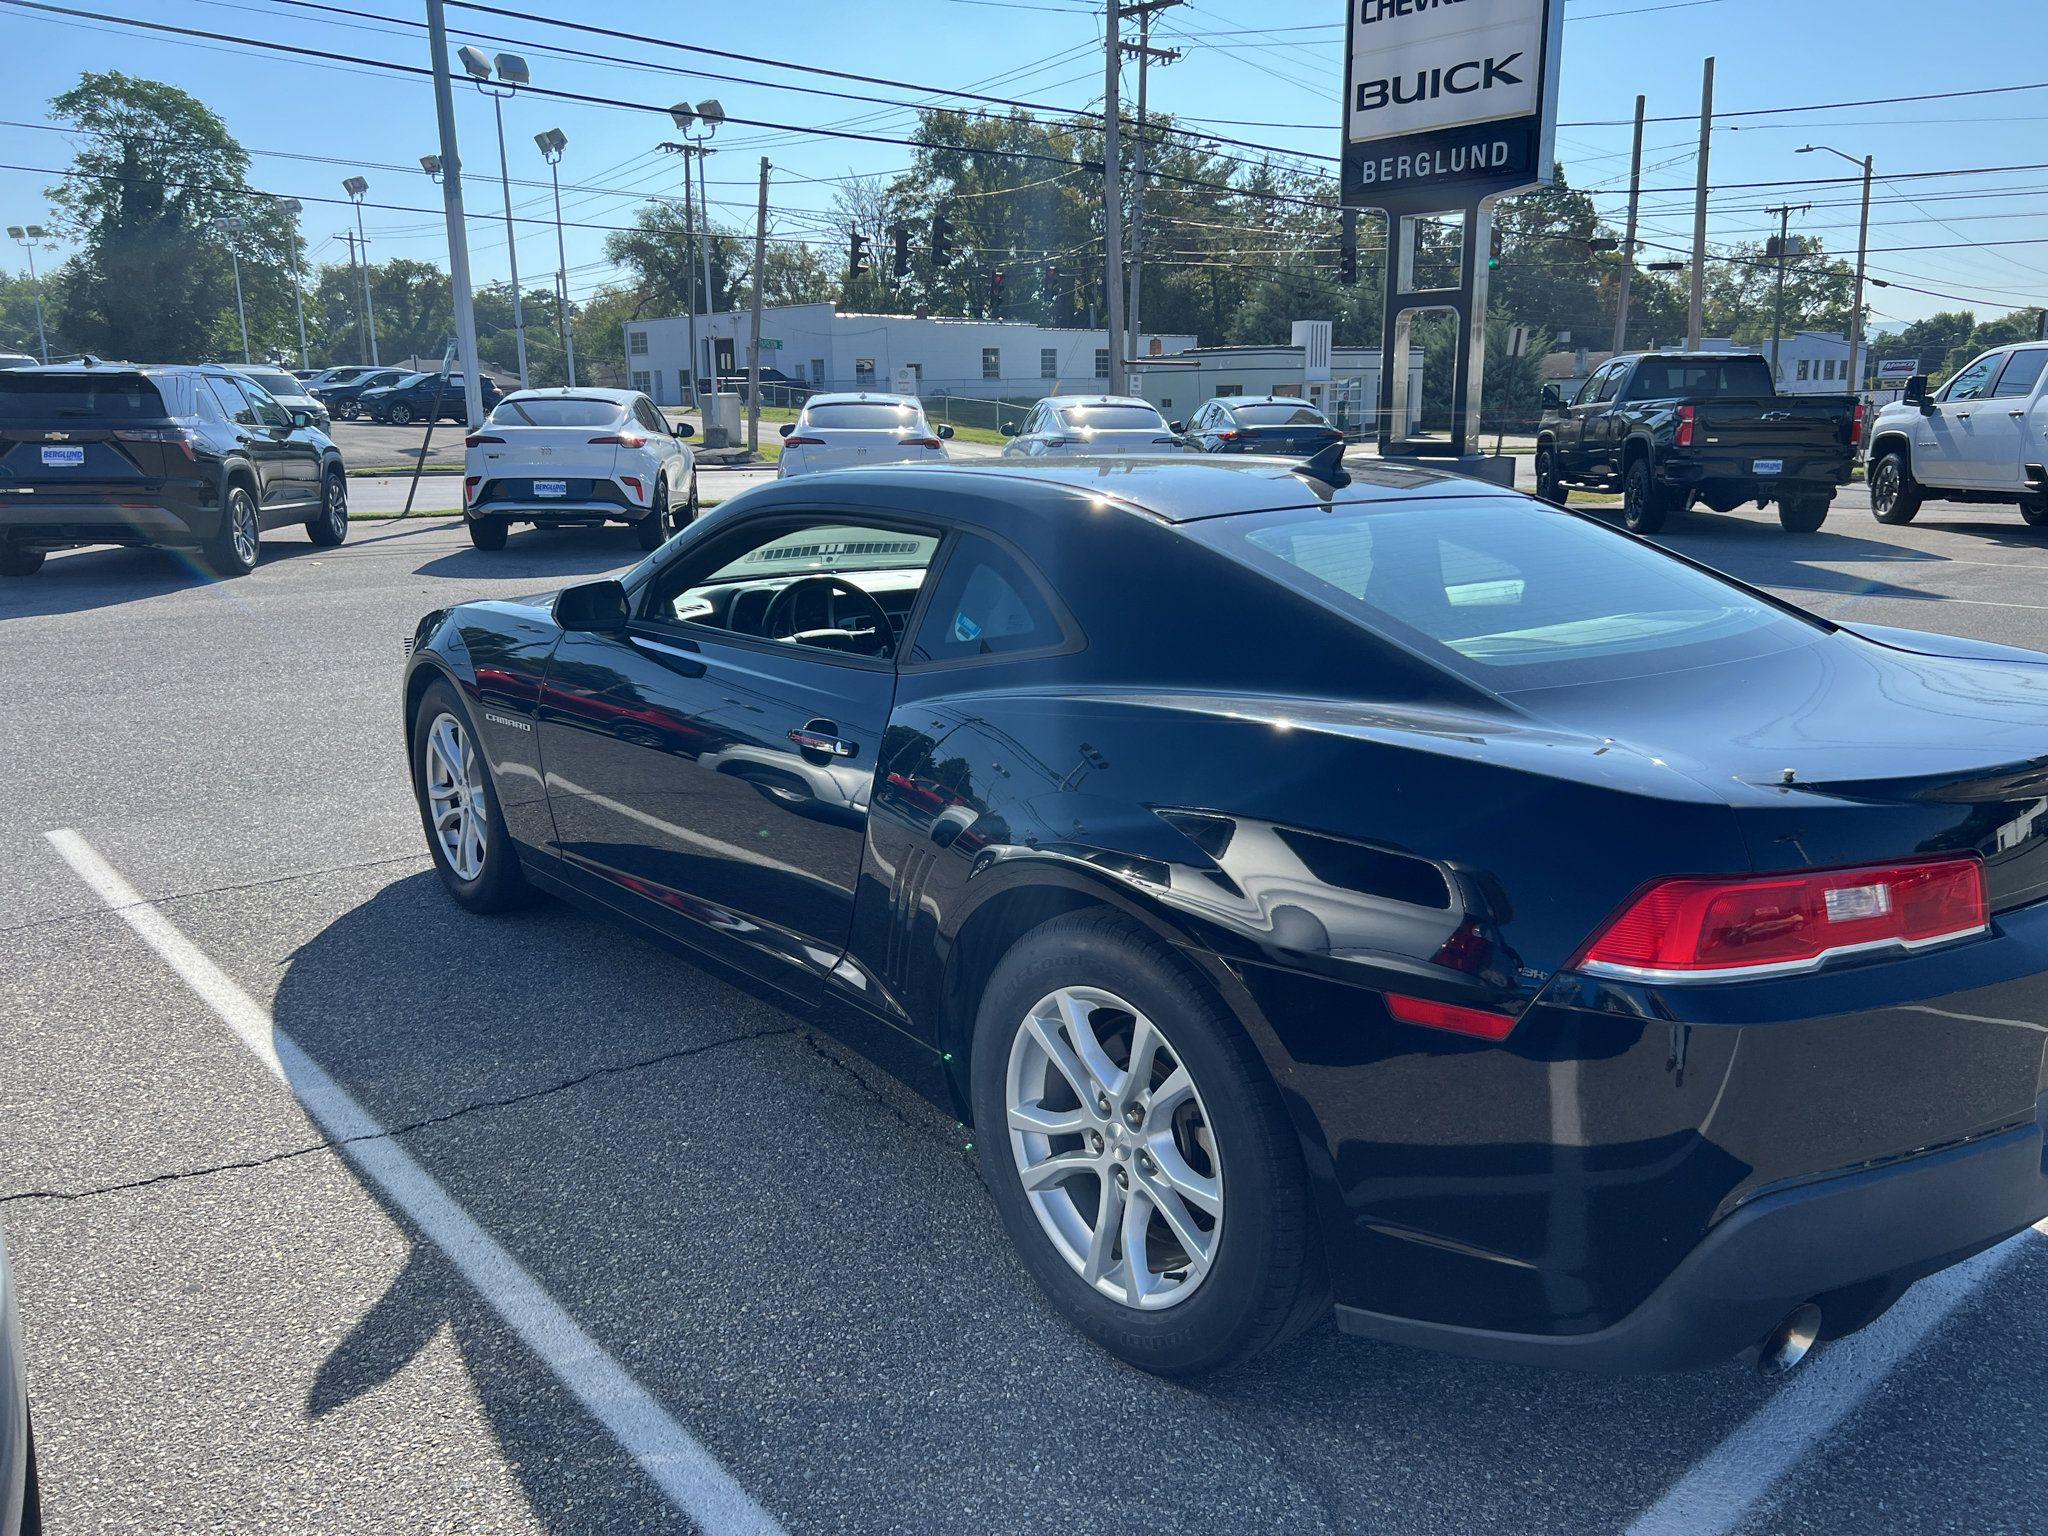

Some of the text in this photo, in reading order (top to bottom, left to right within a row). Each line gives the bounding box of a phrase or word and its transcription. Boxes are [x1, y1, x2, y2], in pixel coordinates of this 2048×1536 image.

[1356, 52, 1523, 112] BUICK
[1362, 141, 1508, 184] BERGLUND
[43, 450, 83, 459] BERGLUND
[535, 483, 566, 492] BERGLUND
[485, 713, 531, 732] CAMARO
